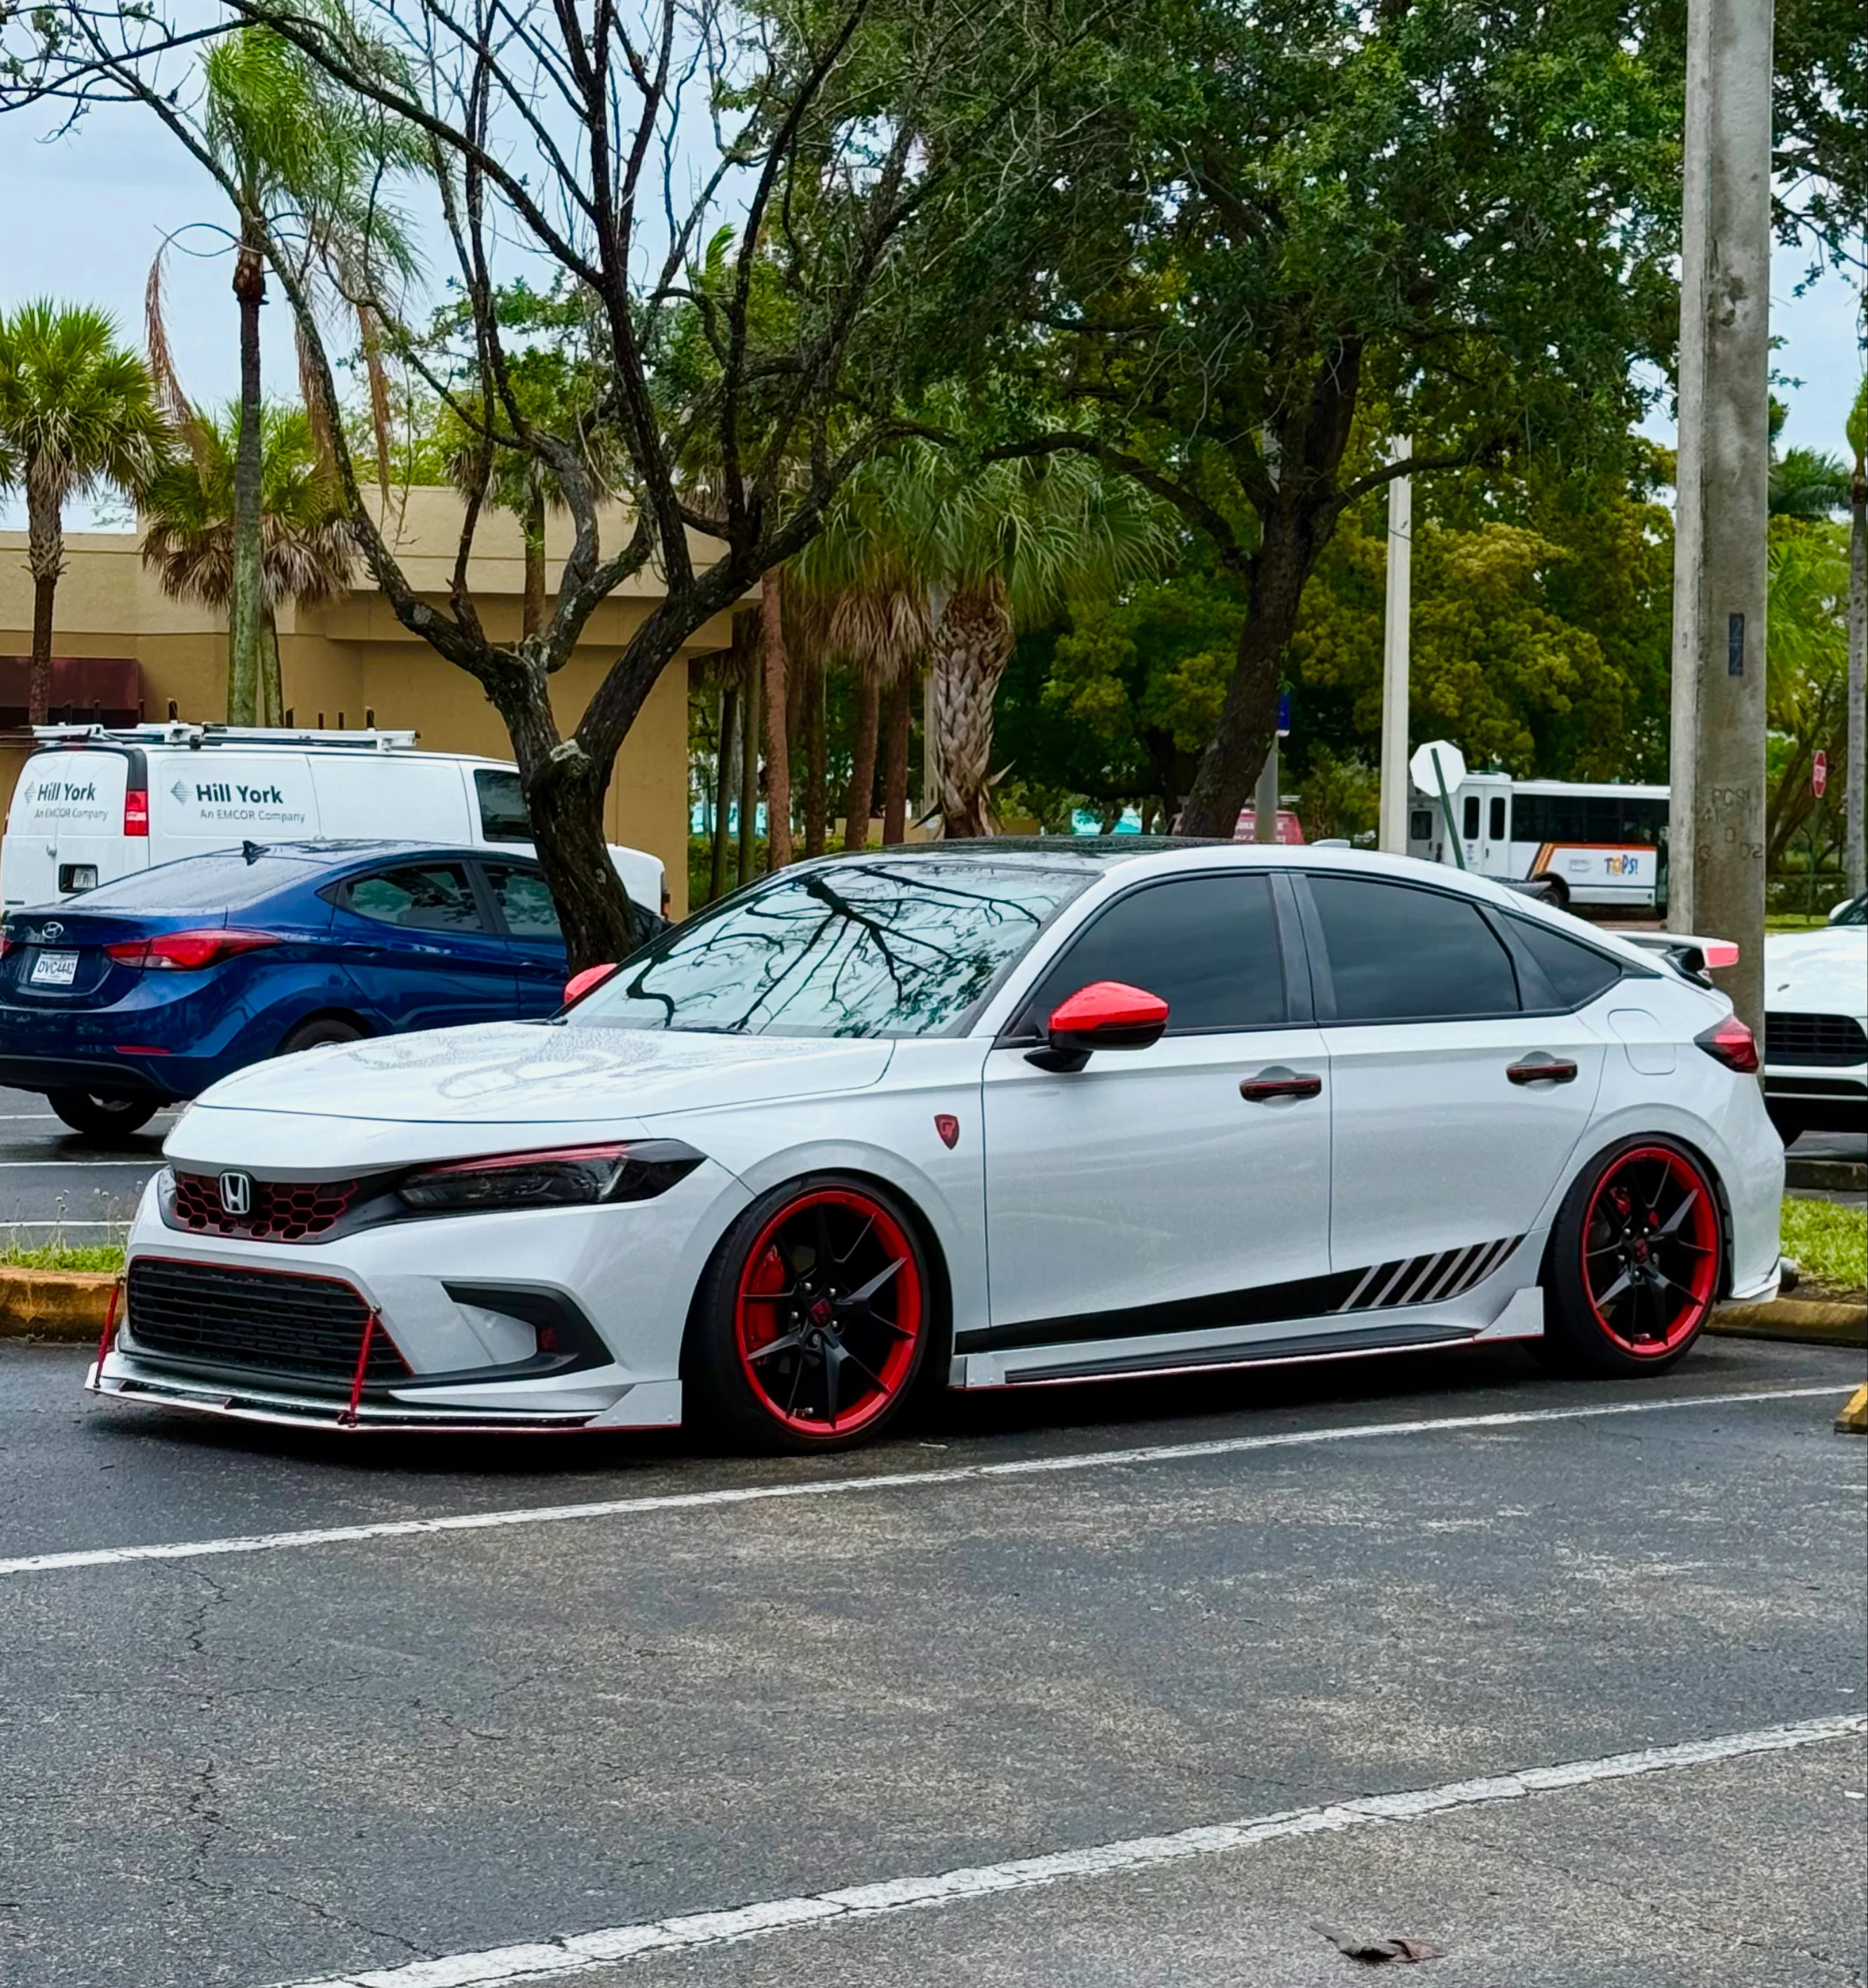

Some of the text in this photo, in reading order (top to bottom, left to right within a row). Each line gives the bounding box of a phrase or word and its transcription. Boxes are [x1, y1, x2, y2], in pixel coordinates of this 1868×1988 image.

[37, 782, 96, 801] Hill York
[196, 783, 284, 804] Hill York
[34, 808, 109, 822] An EMCOR Company
[200, 809, 306, 824] An EMCOR Company
